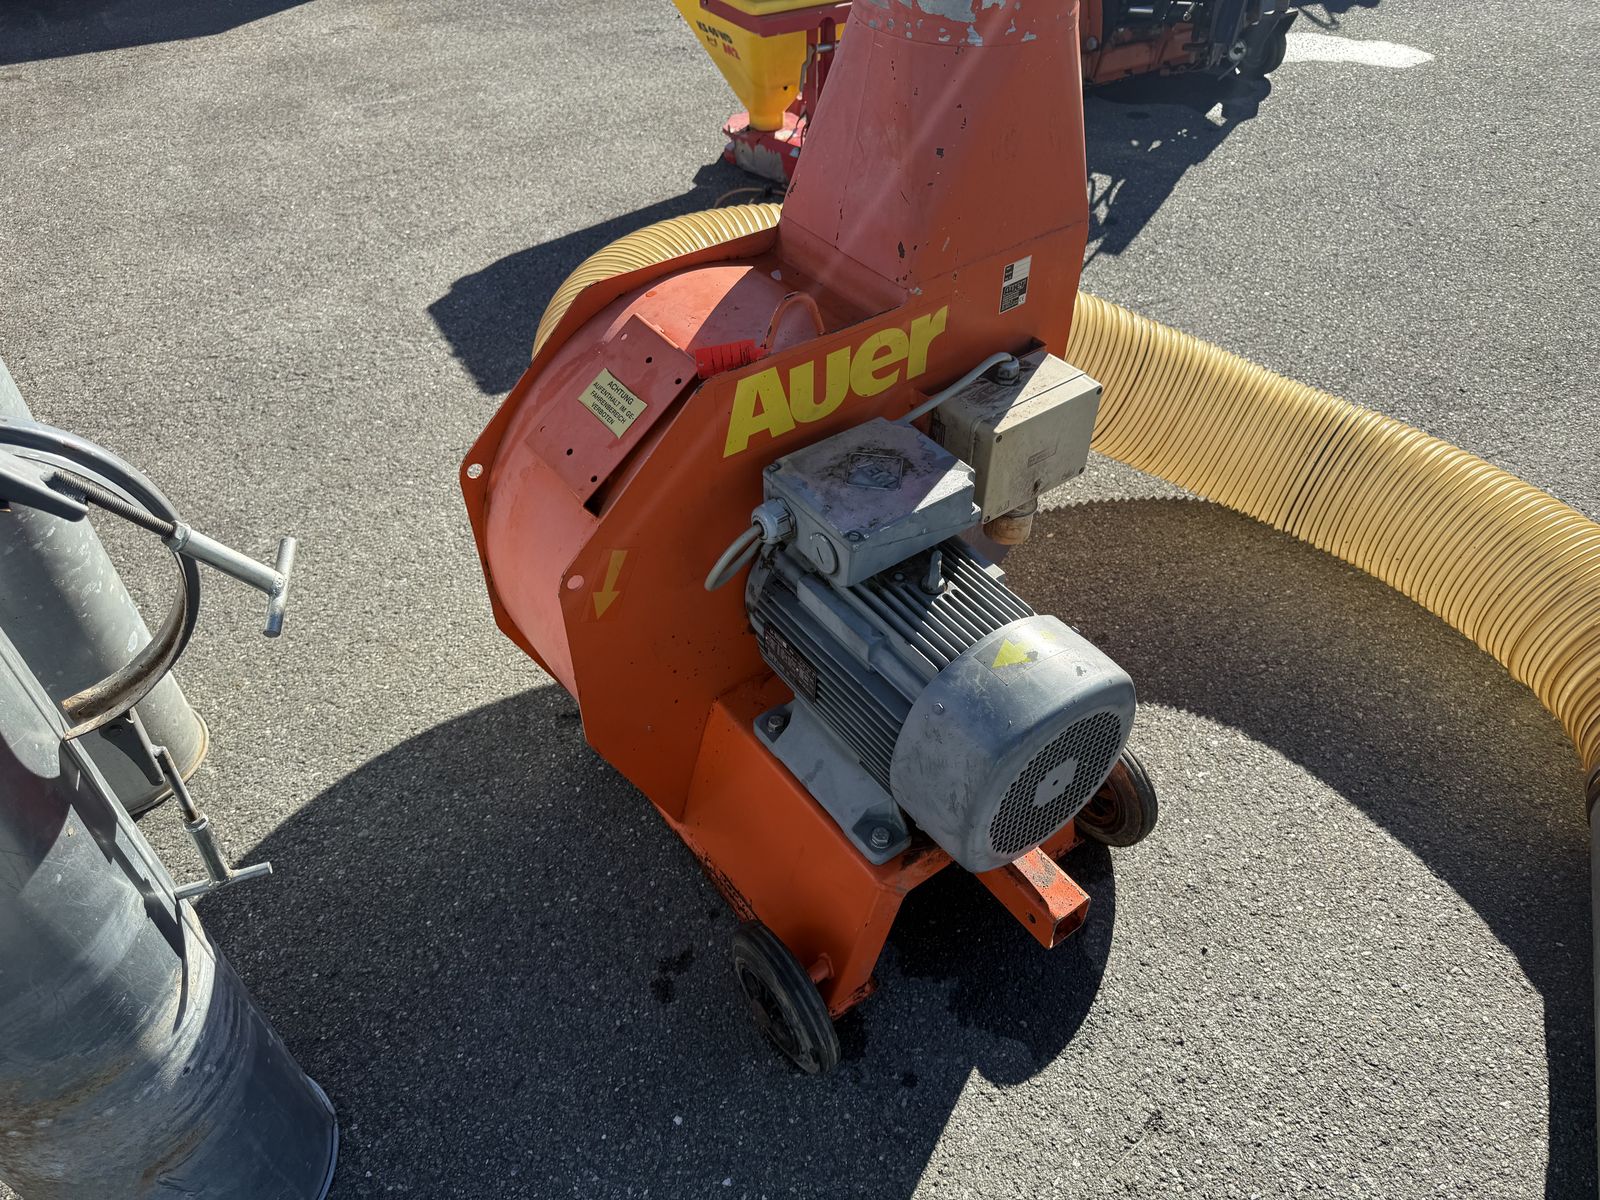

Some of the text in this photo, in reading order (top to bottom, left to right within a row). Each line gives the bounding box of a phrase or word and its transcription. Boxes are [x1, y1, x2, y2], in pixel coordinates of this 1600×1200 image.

[607, 381, 634, 405] ACHTUNG
[723, 305, 948, 458] Auer
[590, 390, 627, 424] FAHRENBEREICH
[593, 382, 621, 407] AUFENTHALT
[619, 405, 627, 413] IM
[591, 402, 615, 425] VERBOTEN
